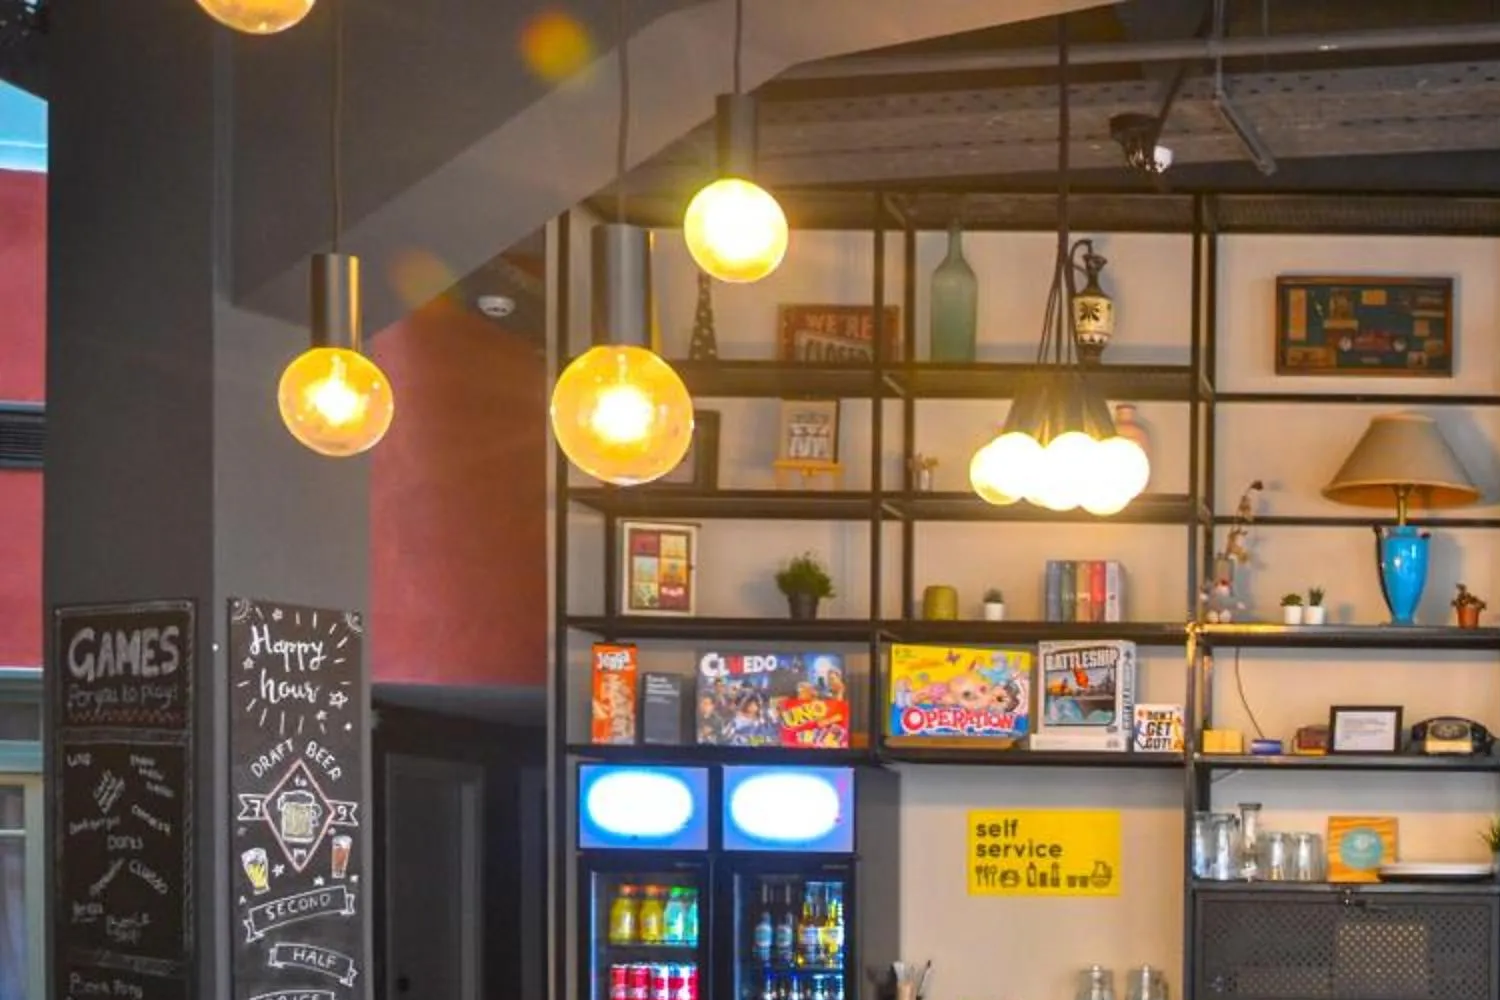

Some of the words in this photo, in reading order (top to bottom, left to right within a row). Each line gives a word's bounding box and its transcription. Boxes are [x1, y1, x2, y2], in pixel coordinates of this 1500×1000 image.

[67, 625, 180, 682] GAMES
[249, 623, 327, 673] Happy
[1045, 647, 1119, 671] BATTLESHIP
[700, 651, 778, 677] CLUEDO
[259, 667, 321, 705] hour
[781, 700, 828, 728] UNO
[901, 705, 1015, 733] OPERATION
[1146, 721, 1171, 737] GET
[250, 737, 294, 779] DRAFT
[305, 740, 343, 781] BEER
[249, 798, 261, 818] 7
[337, 804, 349, 821] 9
[975, 818, 1020, 839] self
[975, 837, 1064, 858] service
[265, 892, 332, 922] SECOND
[293, 948, 338, 969] HALF
